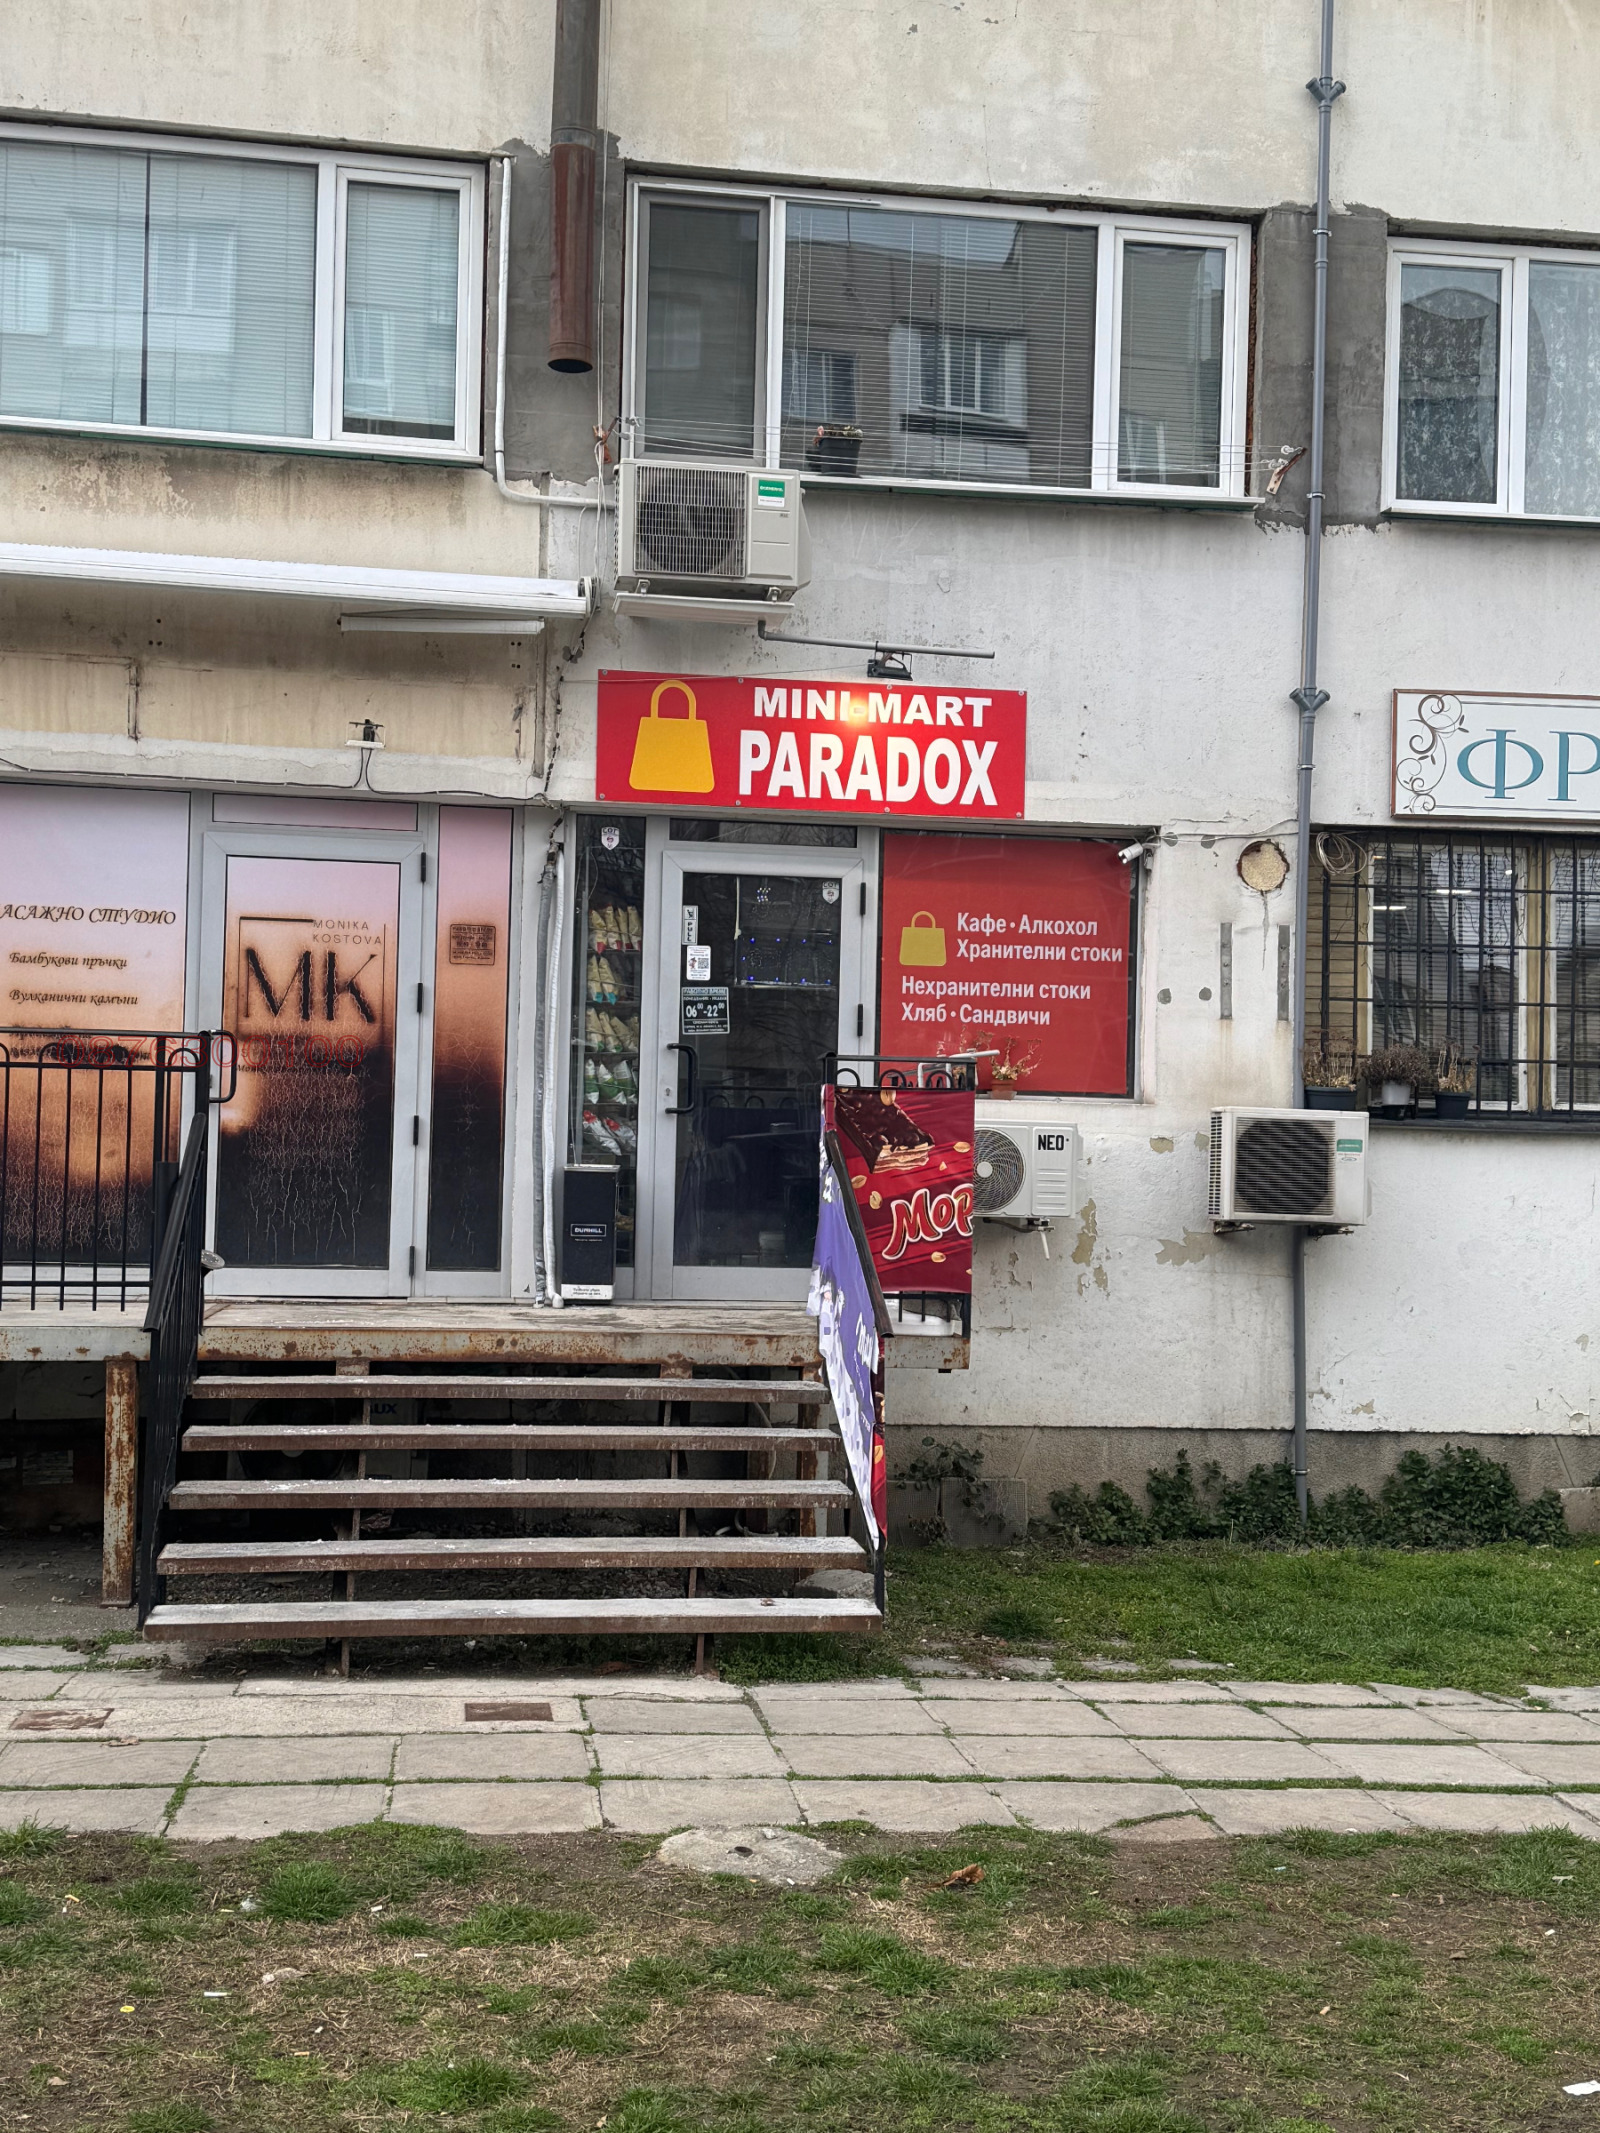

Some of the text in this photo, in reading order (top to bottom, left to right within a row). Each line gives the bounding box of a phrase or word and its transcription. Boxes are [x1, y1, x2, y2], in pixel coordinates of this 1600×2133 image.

[754, 686, 992, 727] MINI-MART
[738, 729, 998, 806] PARADOX
[89, 907, 176, 925] СТУДИО
[312, 919, 369, 930] MONIKA
[957, 912, 1098, 937] Кафе Алкохол
[313, 933, 382, 945] KOSTOVA
[9, 952, 127, 969] Бамбукови пръчки
[956, 938, 1122, 962] Хранителни стоки
[9, 989, 138, 1006] Вулканични камъни
[901, 975, 1091, 999] Нехранителни стоки
[901, 1002, 1051, 1026] Хляб Сандвичи
[1038, 1134, 1065, 1151] NEO
